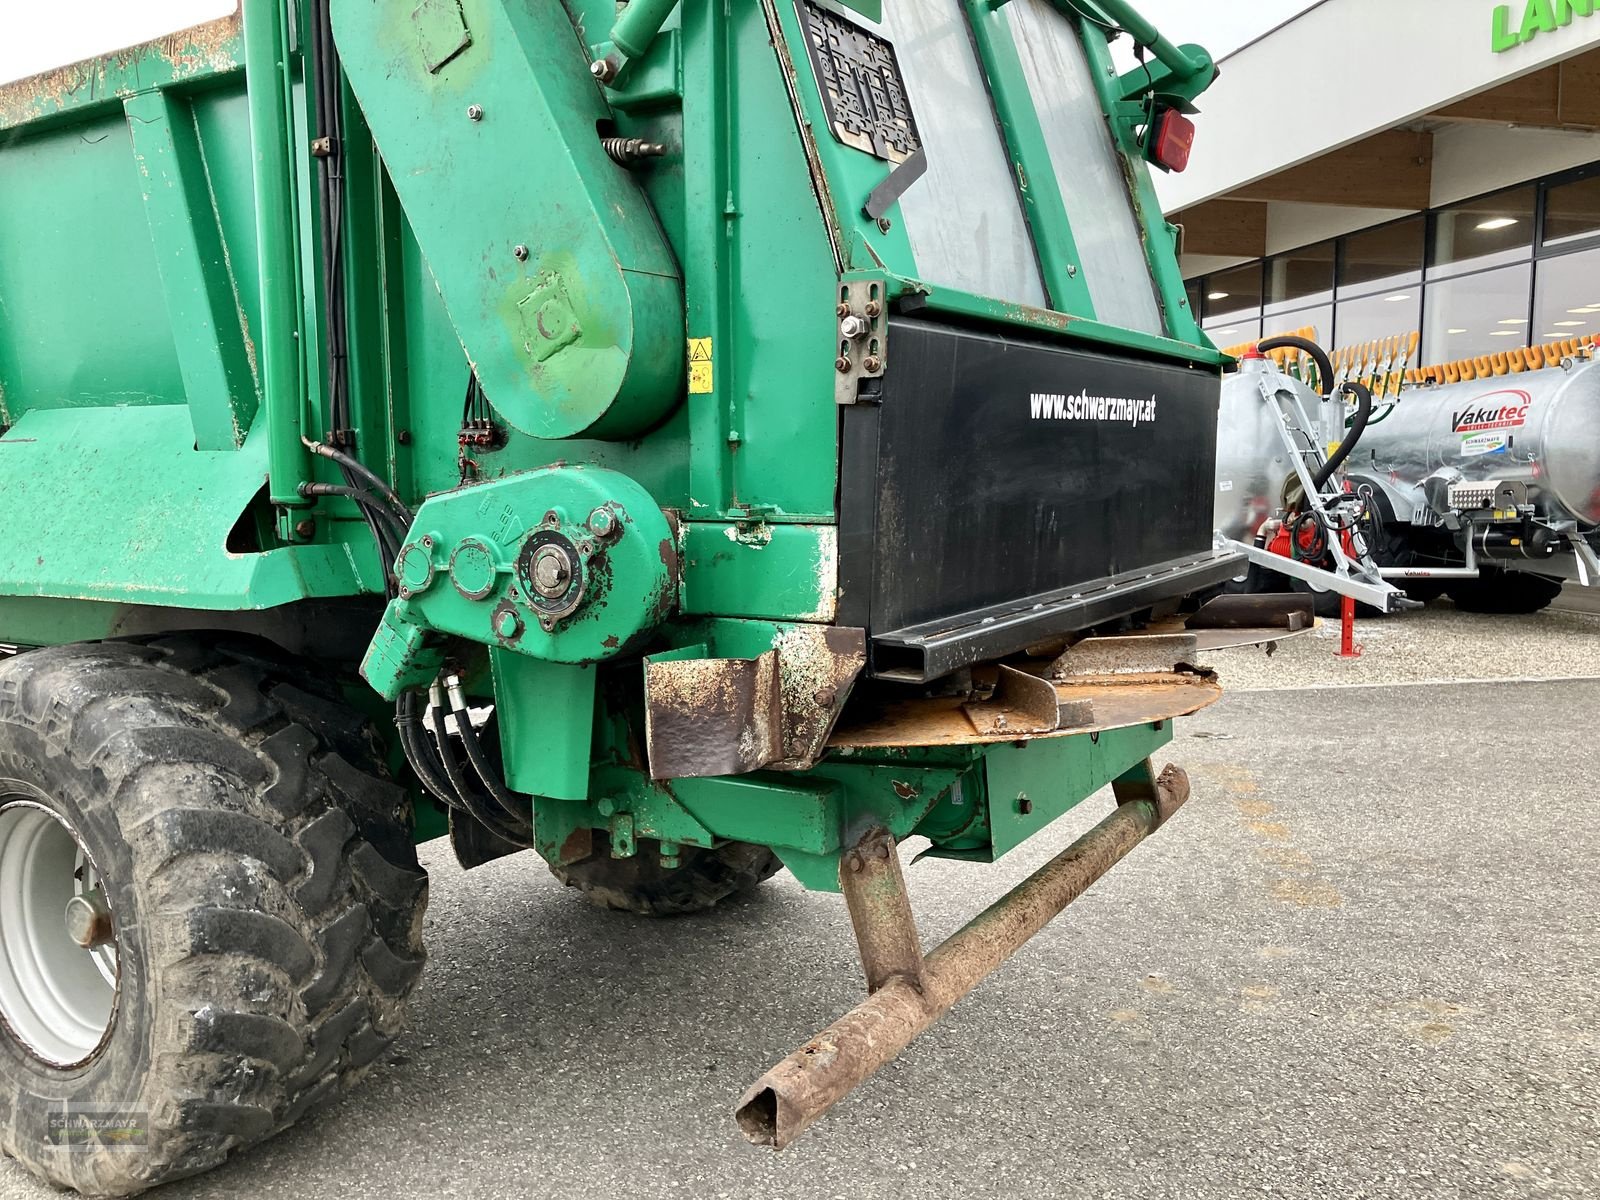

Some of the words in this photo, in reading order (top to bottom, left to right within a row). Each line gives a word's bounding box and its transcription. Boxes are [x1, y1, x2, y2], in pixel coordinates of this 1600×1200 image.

[1491, 0, 1600, 53] LAN
[1030, 388, 1156, 427] www.schwarzmayr.at
[1452, 404, 1529, 432] Vakutec
